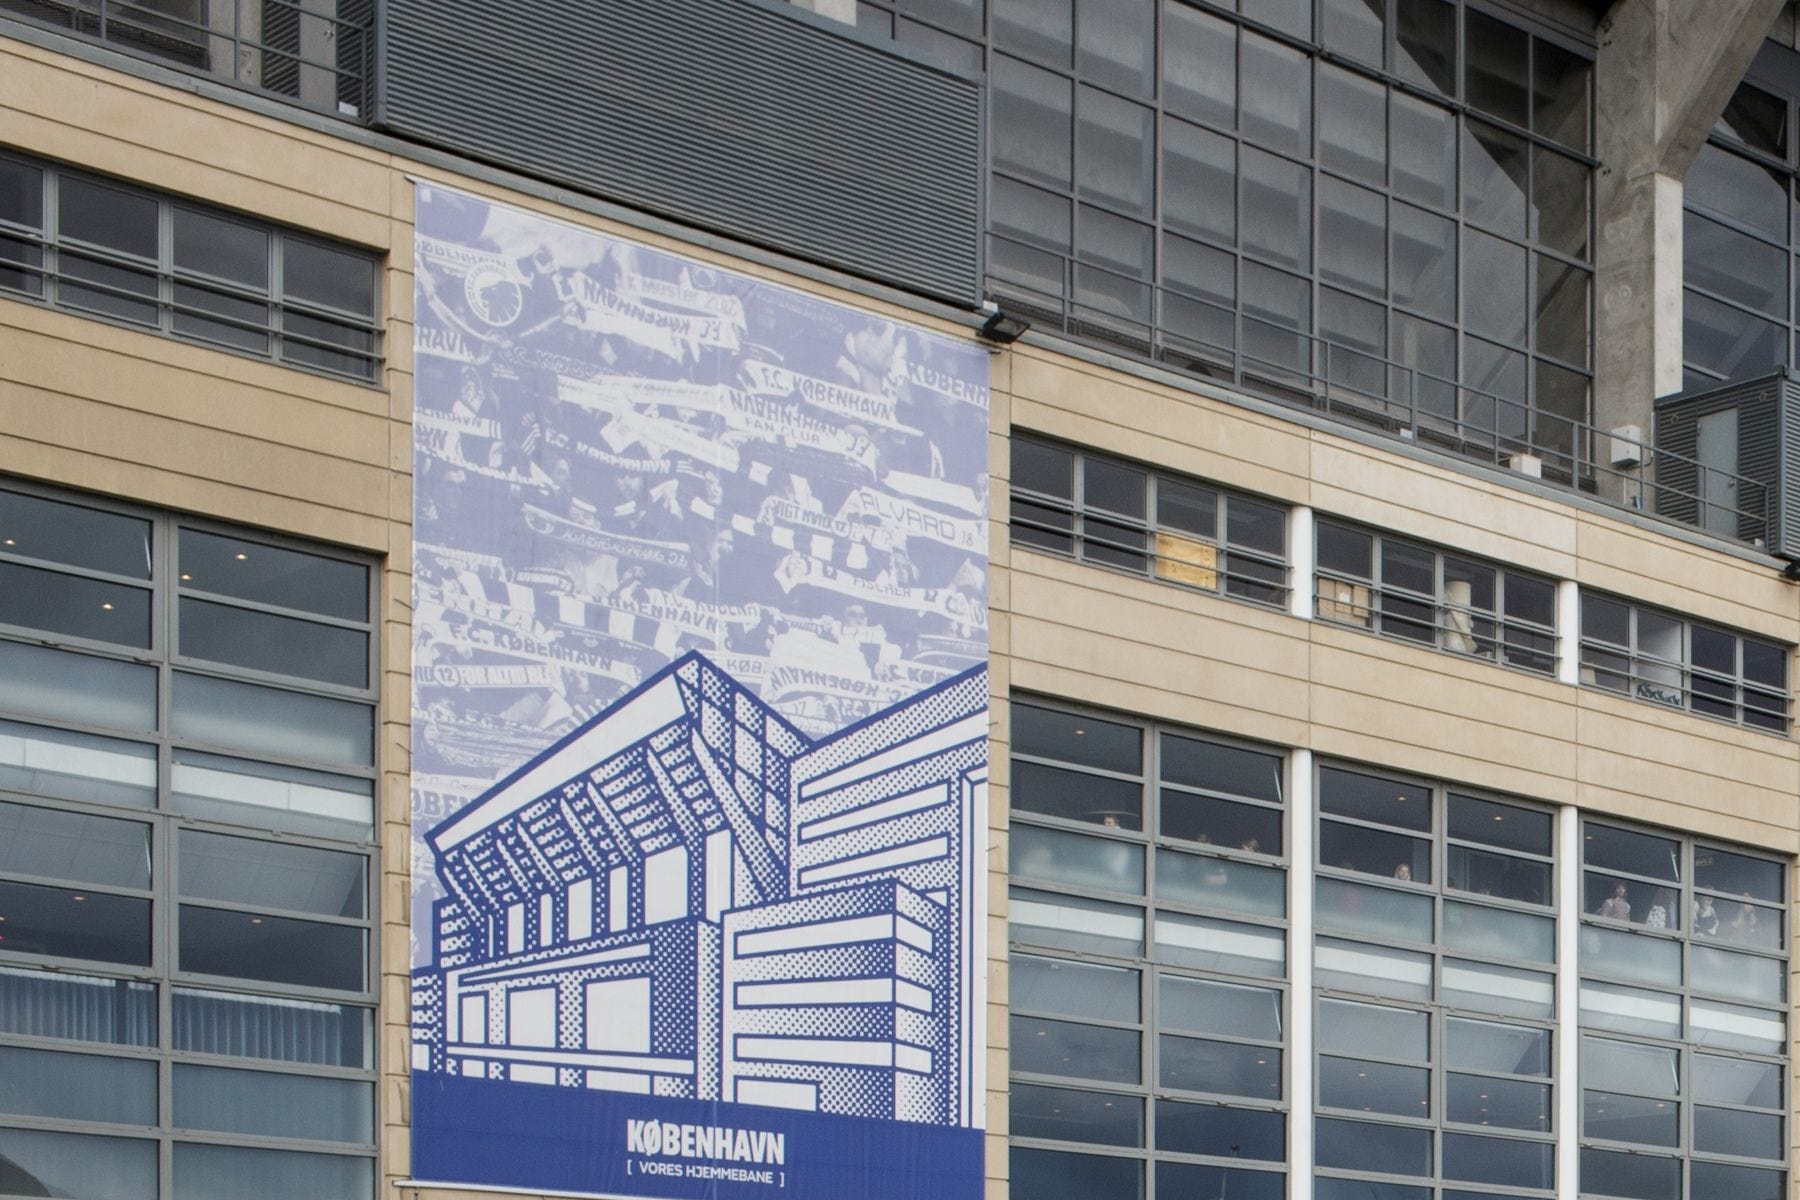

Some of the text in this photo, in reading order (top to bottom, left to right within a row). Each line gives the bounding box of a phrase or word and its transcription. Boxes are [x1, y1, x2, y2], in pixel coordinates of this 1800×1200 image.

[437, 668, 453, 682] 12
[627, 1119, 785, 1165] KØBENHAVN
[639, 1161, 682, 1177] VORES
[686, 1166, 773, 1184] HJEMMEBANE
